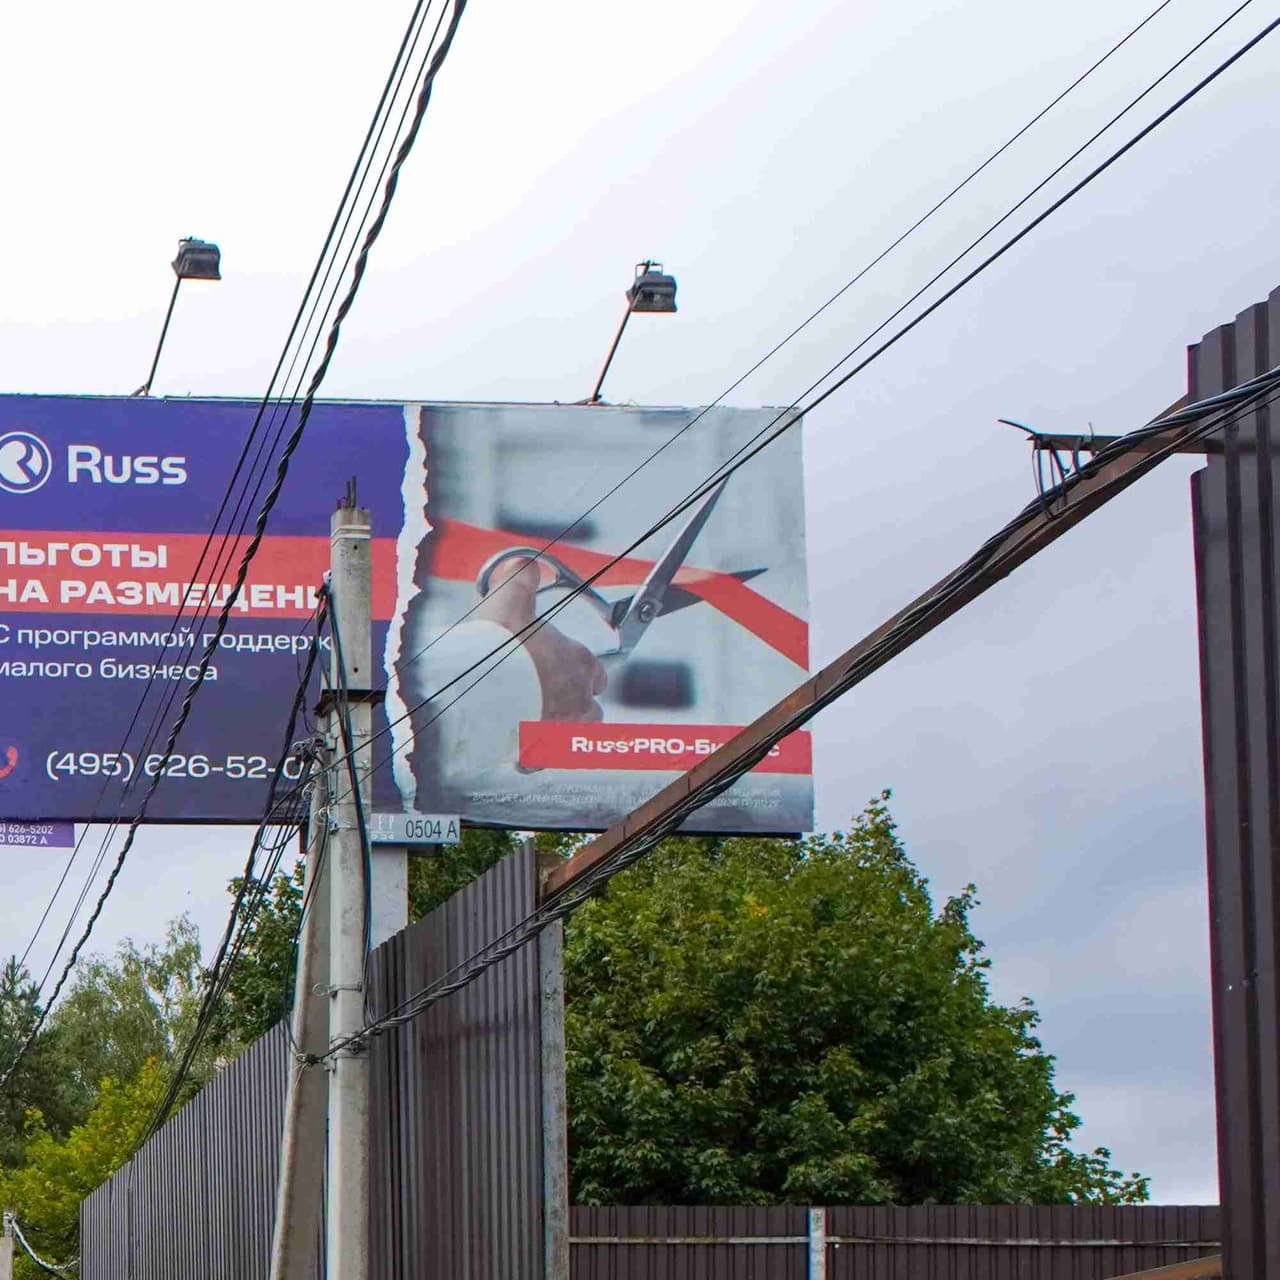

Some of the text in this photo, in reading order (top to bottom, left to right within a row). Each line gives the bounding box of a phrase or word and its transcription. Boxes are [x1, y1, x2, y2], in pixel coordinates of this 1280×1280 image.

[67, 444, 187, 485] Russ
[17, 626, 194, 650] программой
[100, 657, 218, 681] бизнеса
[46, 751, 134, 781] (495)
[8, 824, 53, 835] 626-5202
[405, 820, 441, 838] 0504
